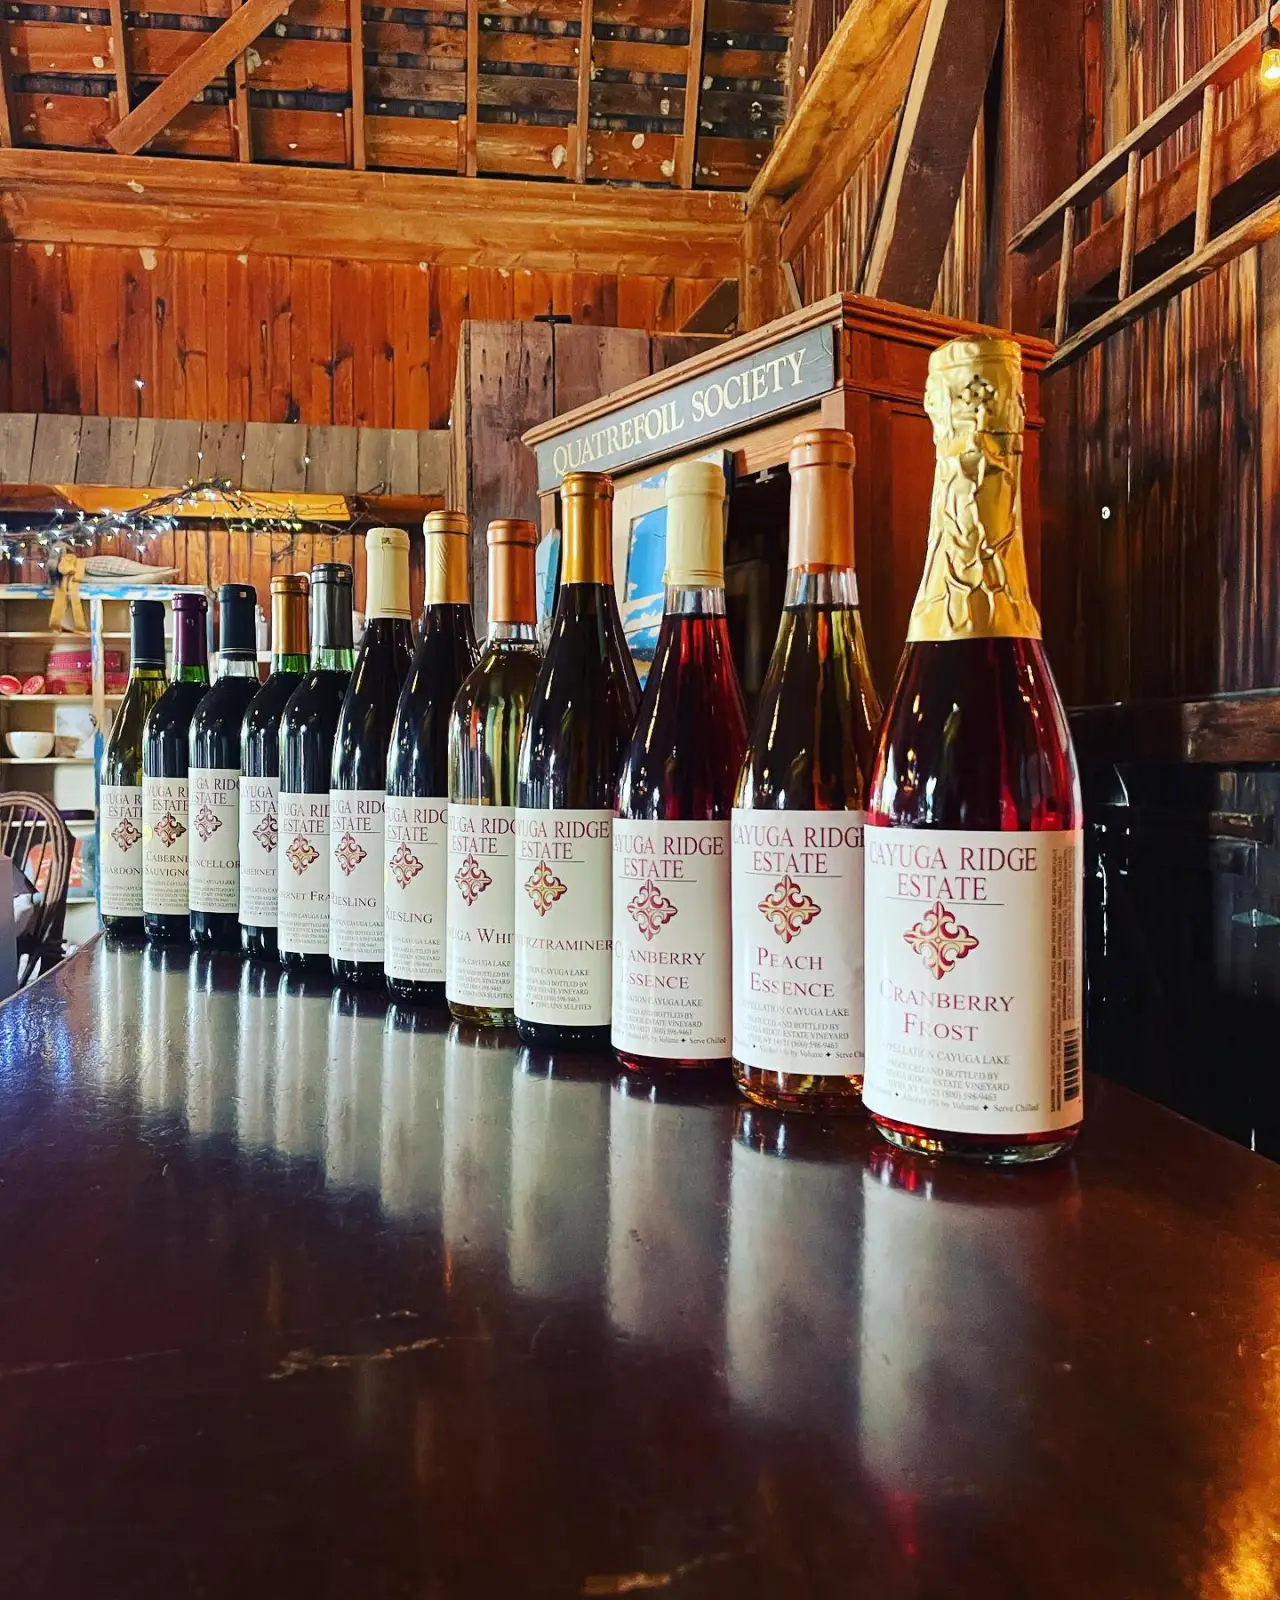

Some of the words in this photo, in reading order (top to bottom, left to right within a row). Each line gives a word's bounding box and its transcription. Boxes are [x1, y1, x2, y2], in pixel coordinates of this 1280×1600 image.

[553, 400, 684, 476] QUATREFOIL
[691, 348, 807, 422] SOCIETY
[152, 799, 188, 812] ESTATE
[283, 818, 324, 833] ESTATE
[332, 816, 372, 831] ESTATE
[554, 820, 610, 839] RIDGE
[387, 825, 428, 842] ESTATE
[452, 836, 498, 854] ESTATE
[521, 840, 573, 860] ESTATE
[664, 836, 724, 856] RIDGE
[753, 850, 828, 874] ESTATE
[869, 841, 948, 870] CAYUGA
[960, 847, 1038, 872] RIDGE
[624, 857, 684, 878] ESTATE
[898, 872, 988, 901] ESTATE
[386, 906, 433, 924] RIESLING
[615, 940, 706, 966] CANBERRY
[756, 946, 824, 970] PEACH
[570, 968, 590, 976] LAKE
[750, 972, 835, 998] ESSENCE
[680, 998, 704, 1007] LAKE
[880, 978, 1015, 1012] CRANBERRY
[786, 1006, 824, 1017] CAYUGA
[824, 1008, 850, 1017] LAKE
[793, 1022, 828, 1030] BOTTLED
[829, 1022, 840, 1030] BY
[904, 1012, 978, 1042] FROST
[810, 1032, 850, 1040] VINEYARD
[834, 1050, 853, 1059] Serve
[936, 1050, 981, 1065] CAYUGA
[982, 1054, 1011, 1066] LAKE
[932, 1077, 965, 1090] ESTATE
[965, 1081, 1010, 1092] VINEYARD
[944, 1070, 986, 1080] BOTTLED
[986, 1072, 1000, 1081] BY
[952, 1101, 980, 1112] Volume
[993, 1104, 1014, 1112] Serve
[1014, 1102, 1040, 1112] Chilled
